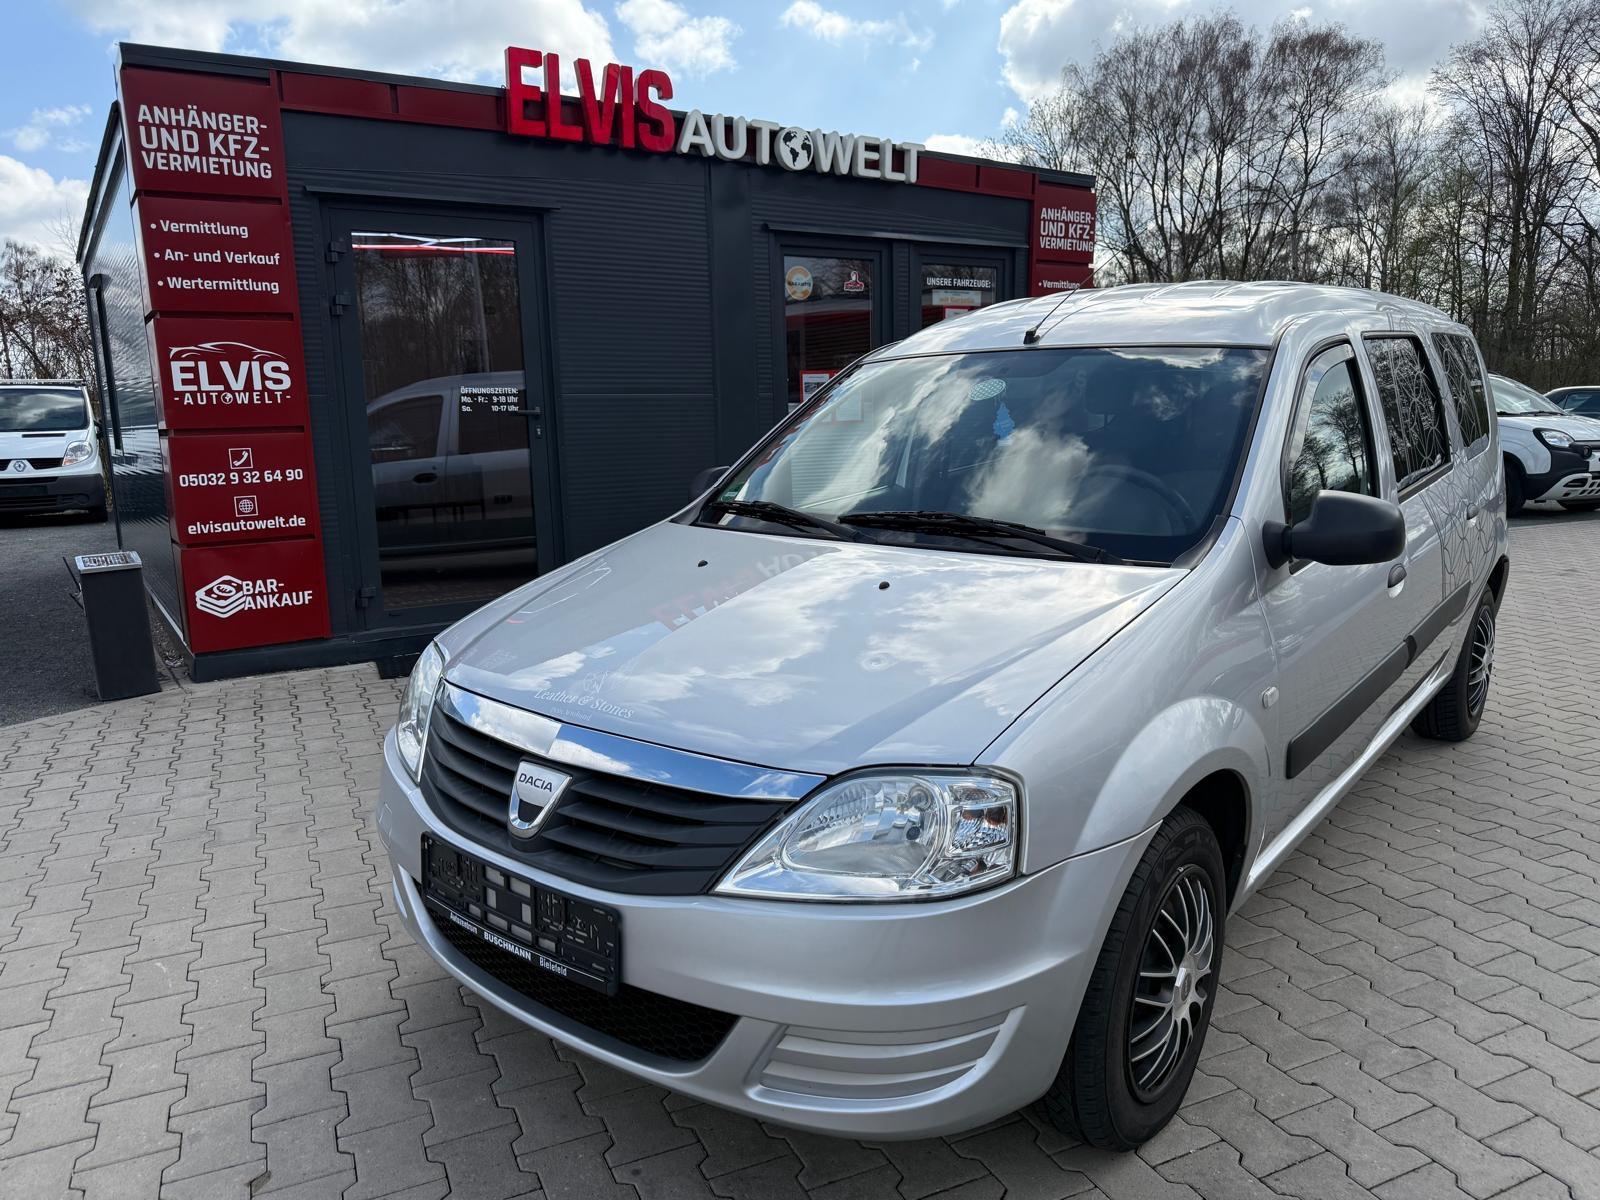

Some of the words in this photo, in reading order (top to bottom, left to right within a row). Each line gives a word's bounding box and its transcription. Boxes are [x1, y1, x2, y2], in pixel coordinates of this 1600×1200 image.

[504, 46, 675, 153] ELVIS
[137, 104, 268, 135] ANHÄNGER-
[139, 125, 200, 153] UND
[208, 132, 270, 159] KFZ-
[141, 150, 273, 179] VERMIETUNG
[1040, 206, 1095, 224] ANHÄNGER-
[160, 219, 249, 239] Vermittlung
[1040, 220, 1065, 237] UND
[1068, 223, 1095, 240] KFZ-
[1040, 236, 1094, 252] VERMIETUNG
[164, 248, 190, 261] An-
[193, 249, 221, 263] und
[225, 251, 280, 266] Verkauf
[167, 276, 280, 294] Wertermittlung
[926, 277, 952, 287] UNSERE
[170, 360, 292, 392] ELVIS
[460, 385, 519, 394] ÖFFNUNGSZEITEN:
[507, 395, 519, 403] Uhr
[179, 472, 226, 487] 05032
[230, 471, 239, 485] 9
[242, 470, 261, 484] 32
[264, 469, 283, 482] 64
[286, 468, 304, 481] 90
[187, 514, 306, 535] elvisautowelt.de
[242, 578, 285, 595] BAR-
[244, 590, 313, 611] ANKAUF
[534, 687, 577, 705] Leather
[591, 698, 635, 719] Stones
[518, 772, 553, 793] DACIA
[483, 931, 532, 962] BUSCHMANN
[539, 956, 567, 977] Bielefeld
